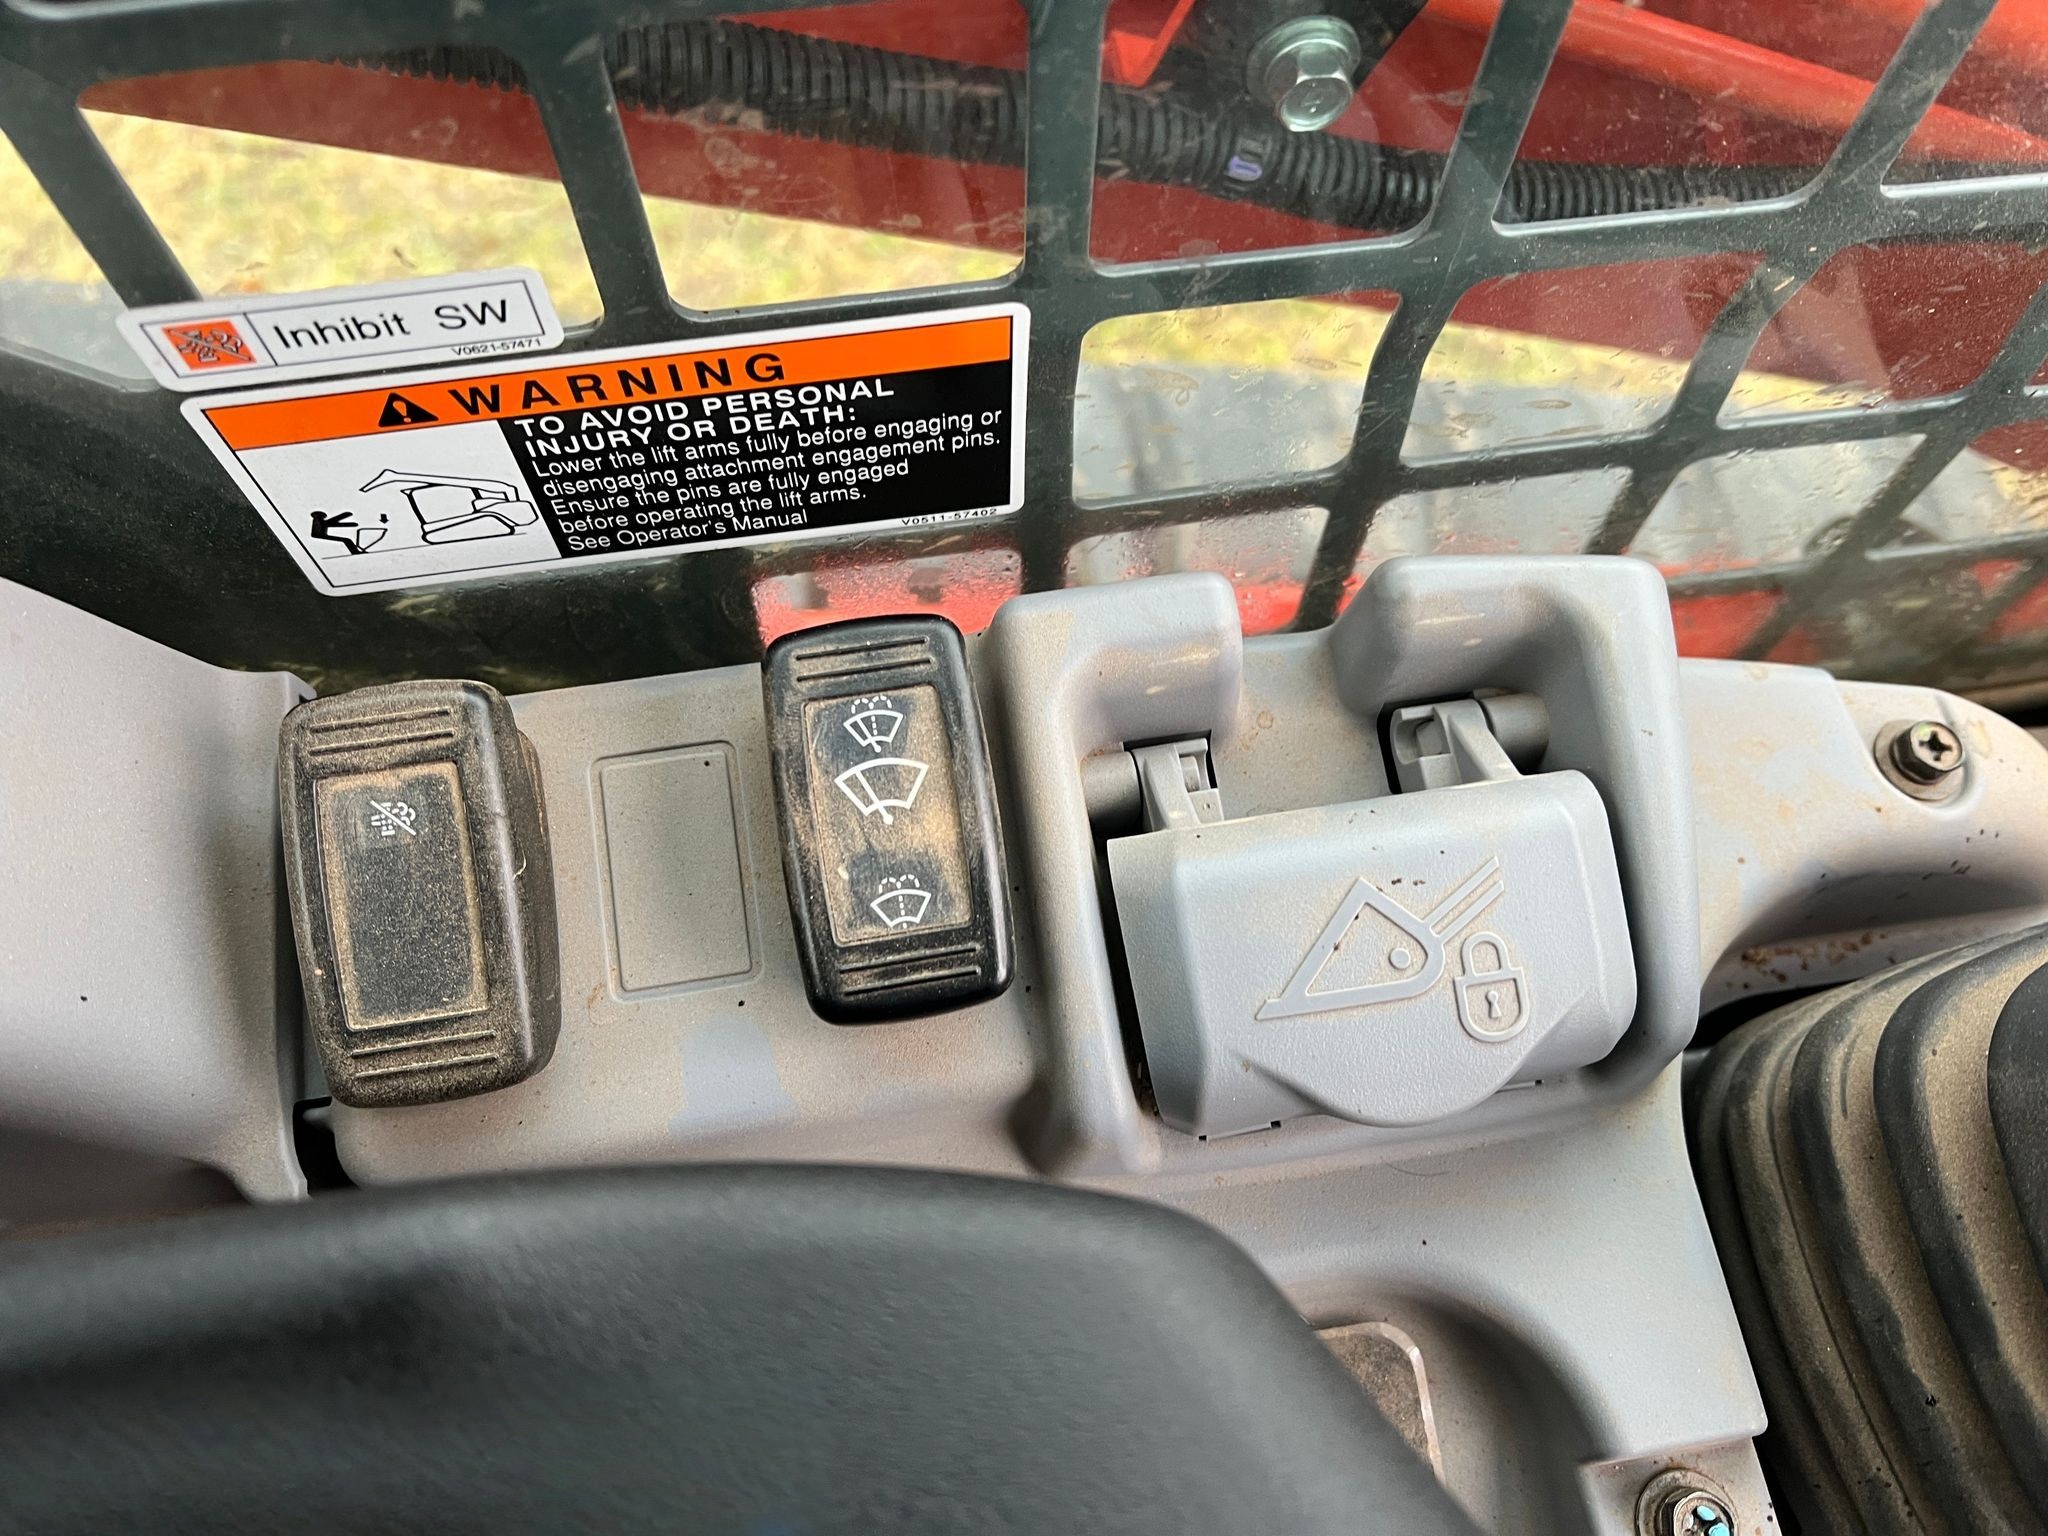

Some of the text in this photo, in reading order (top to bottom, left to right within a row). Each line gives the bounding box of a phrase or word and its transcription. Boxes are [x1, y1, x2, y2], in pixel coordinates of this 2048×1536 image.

[274, 299, 508, 349] Inhibit SW
[451, 338, 542, 357] V0621-57471
[448, 353, 786, 416] WARNING
[514, 378, 895, 437] TO AVOID PERSONAL
[525, 407, 856, 457] INJURY OR DEATH:
[532, 410, 1002, 477] Lower the lift arms fully before engaging or
[543, 429, 1001, 497] disengaging attachment engagement pins.
[551, 459, 909, 516] Ensure the pins are fully engaged
[558, 485, 867, 534] before operating the lift arms.
[567, 508, 808, 552] See Operator's Manual
[901, 508, 998, 526] V0511-57402
